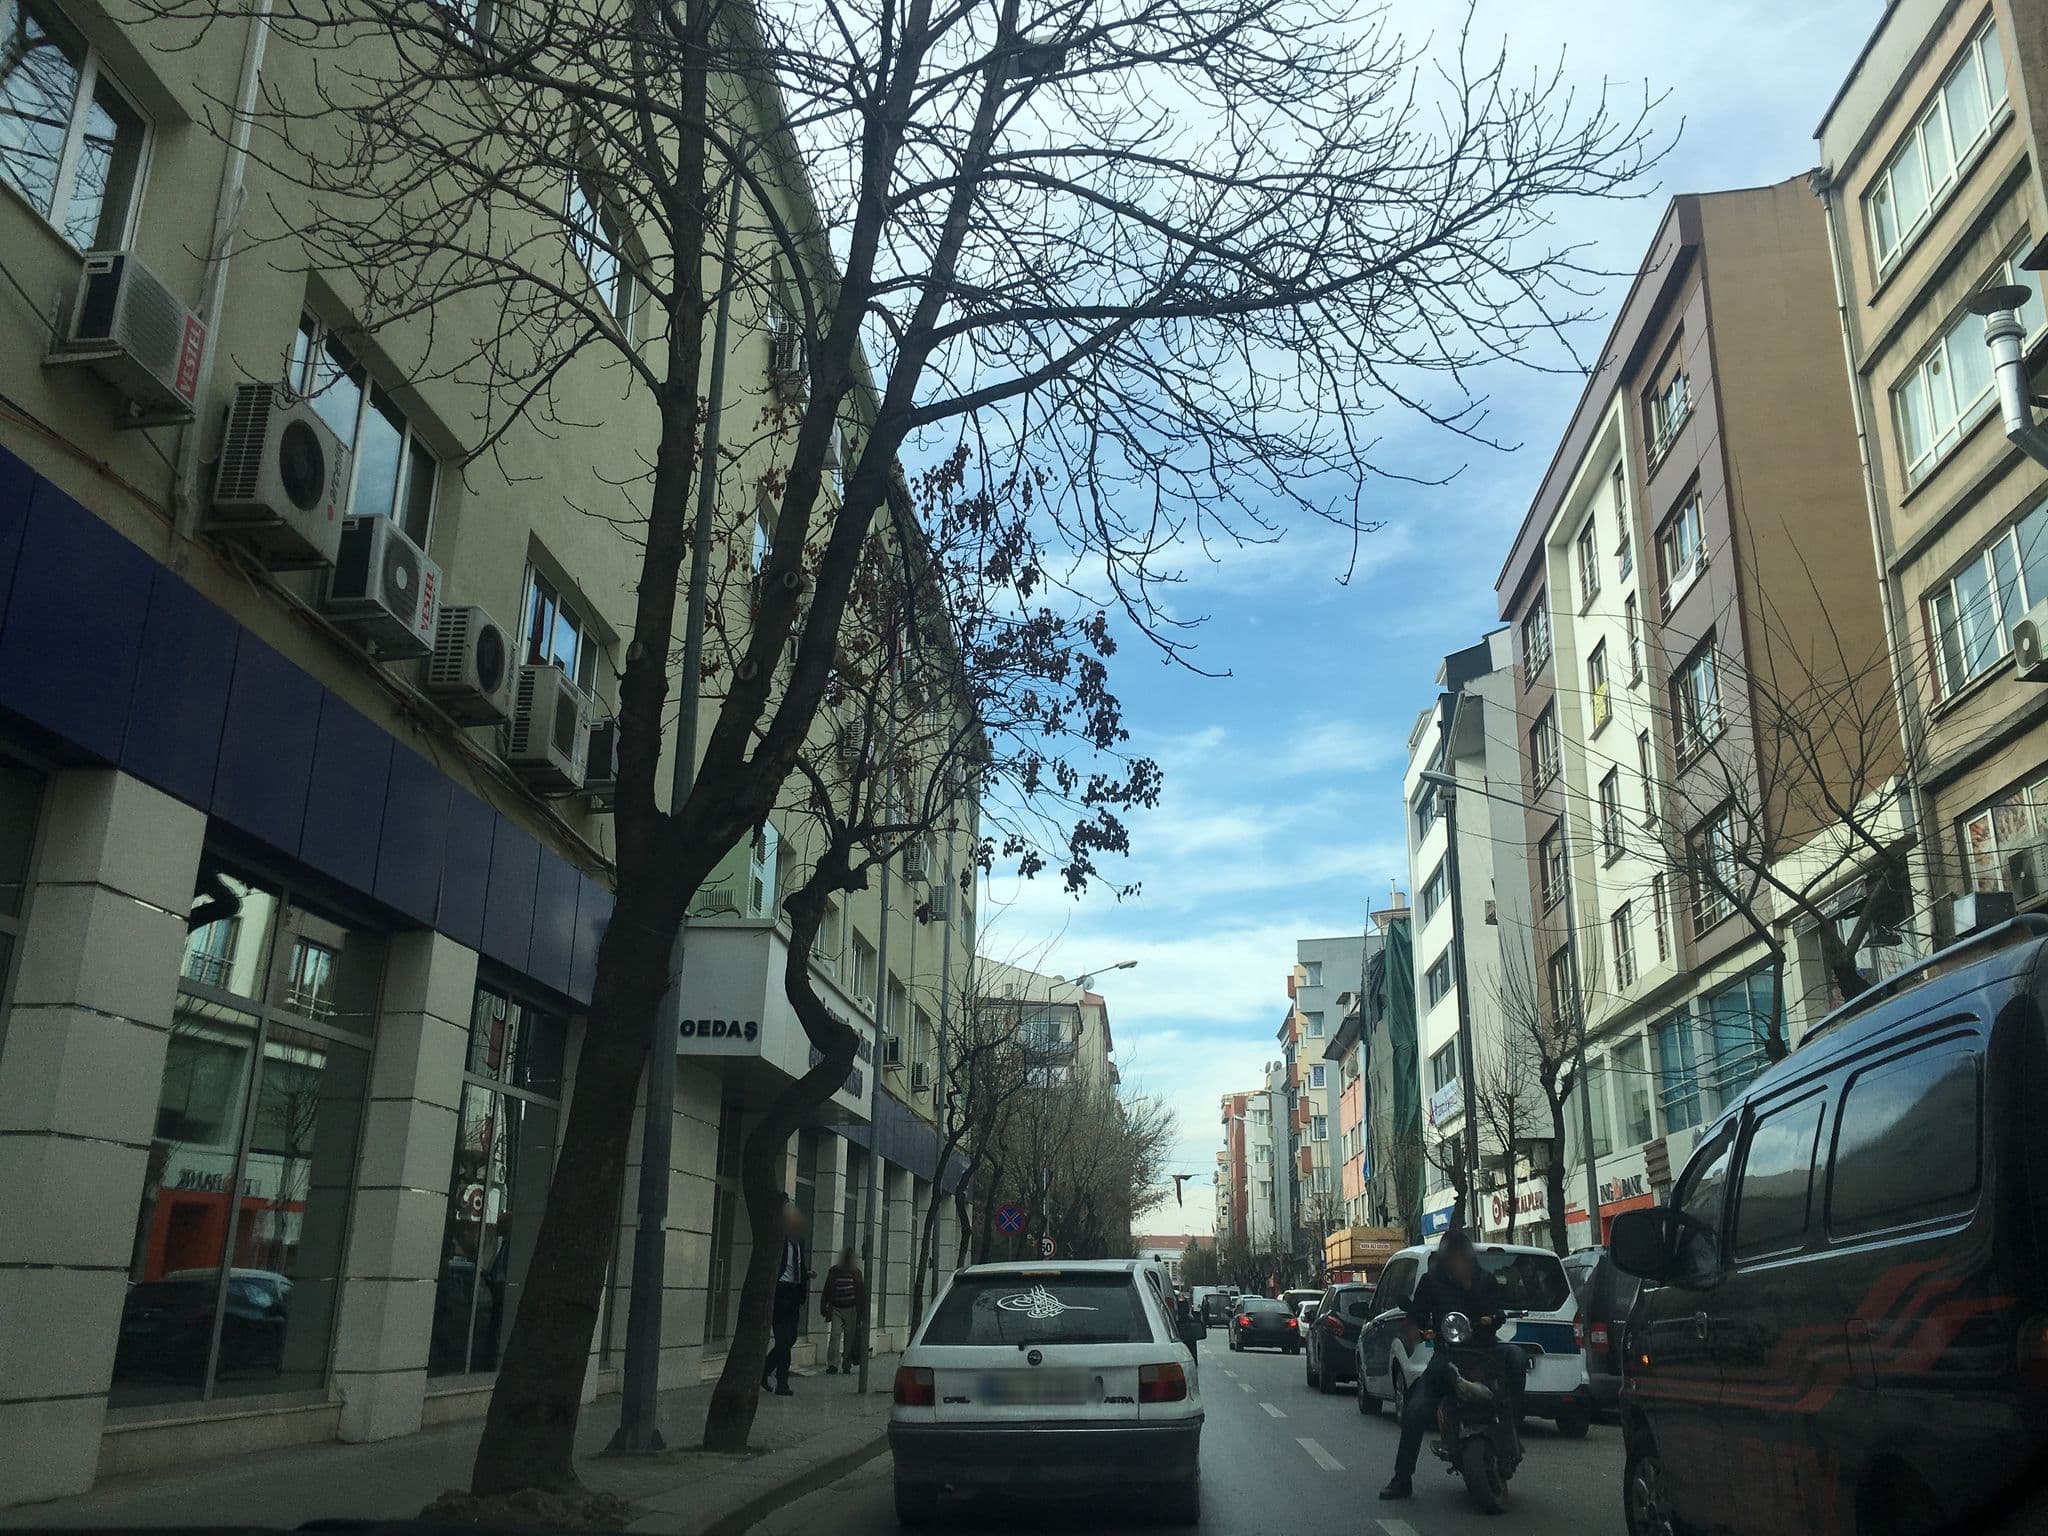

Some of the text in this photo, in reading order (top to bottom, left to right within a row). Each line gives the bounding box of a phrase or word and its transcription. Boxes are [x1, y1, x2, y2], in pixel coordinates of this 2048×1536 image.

[180, 327, 202, 393] VESTEL
[420, 572, 435, 631] VESTEL
[679, 1019, 758, 1042] OEDAŞ
[1621, 1174, 1645, 1198] BANK
[1104, 1396, 1134, 1404] ASTRA
